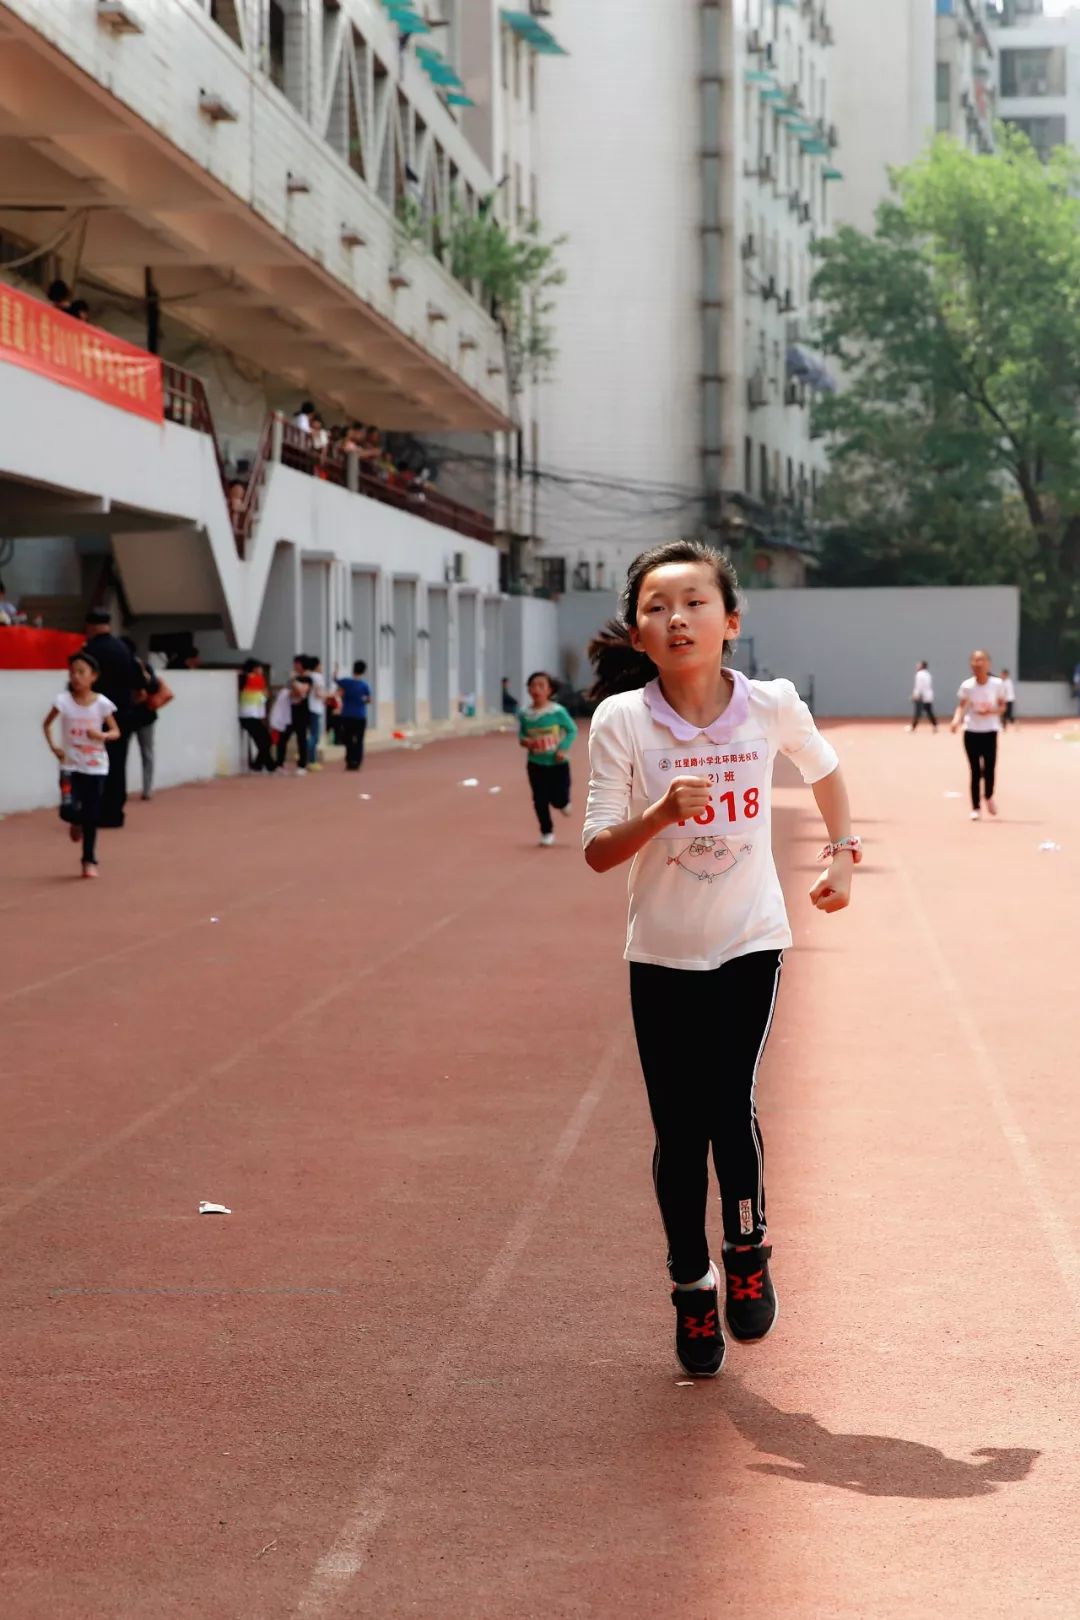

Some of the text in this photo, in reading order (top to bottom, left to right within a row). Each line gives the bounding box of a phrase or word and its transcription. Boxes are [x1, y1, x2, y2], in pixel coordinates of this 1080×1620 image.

[674, 751, 759, 768] 红星路小学北环阳光校区
